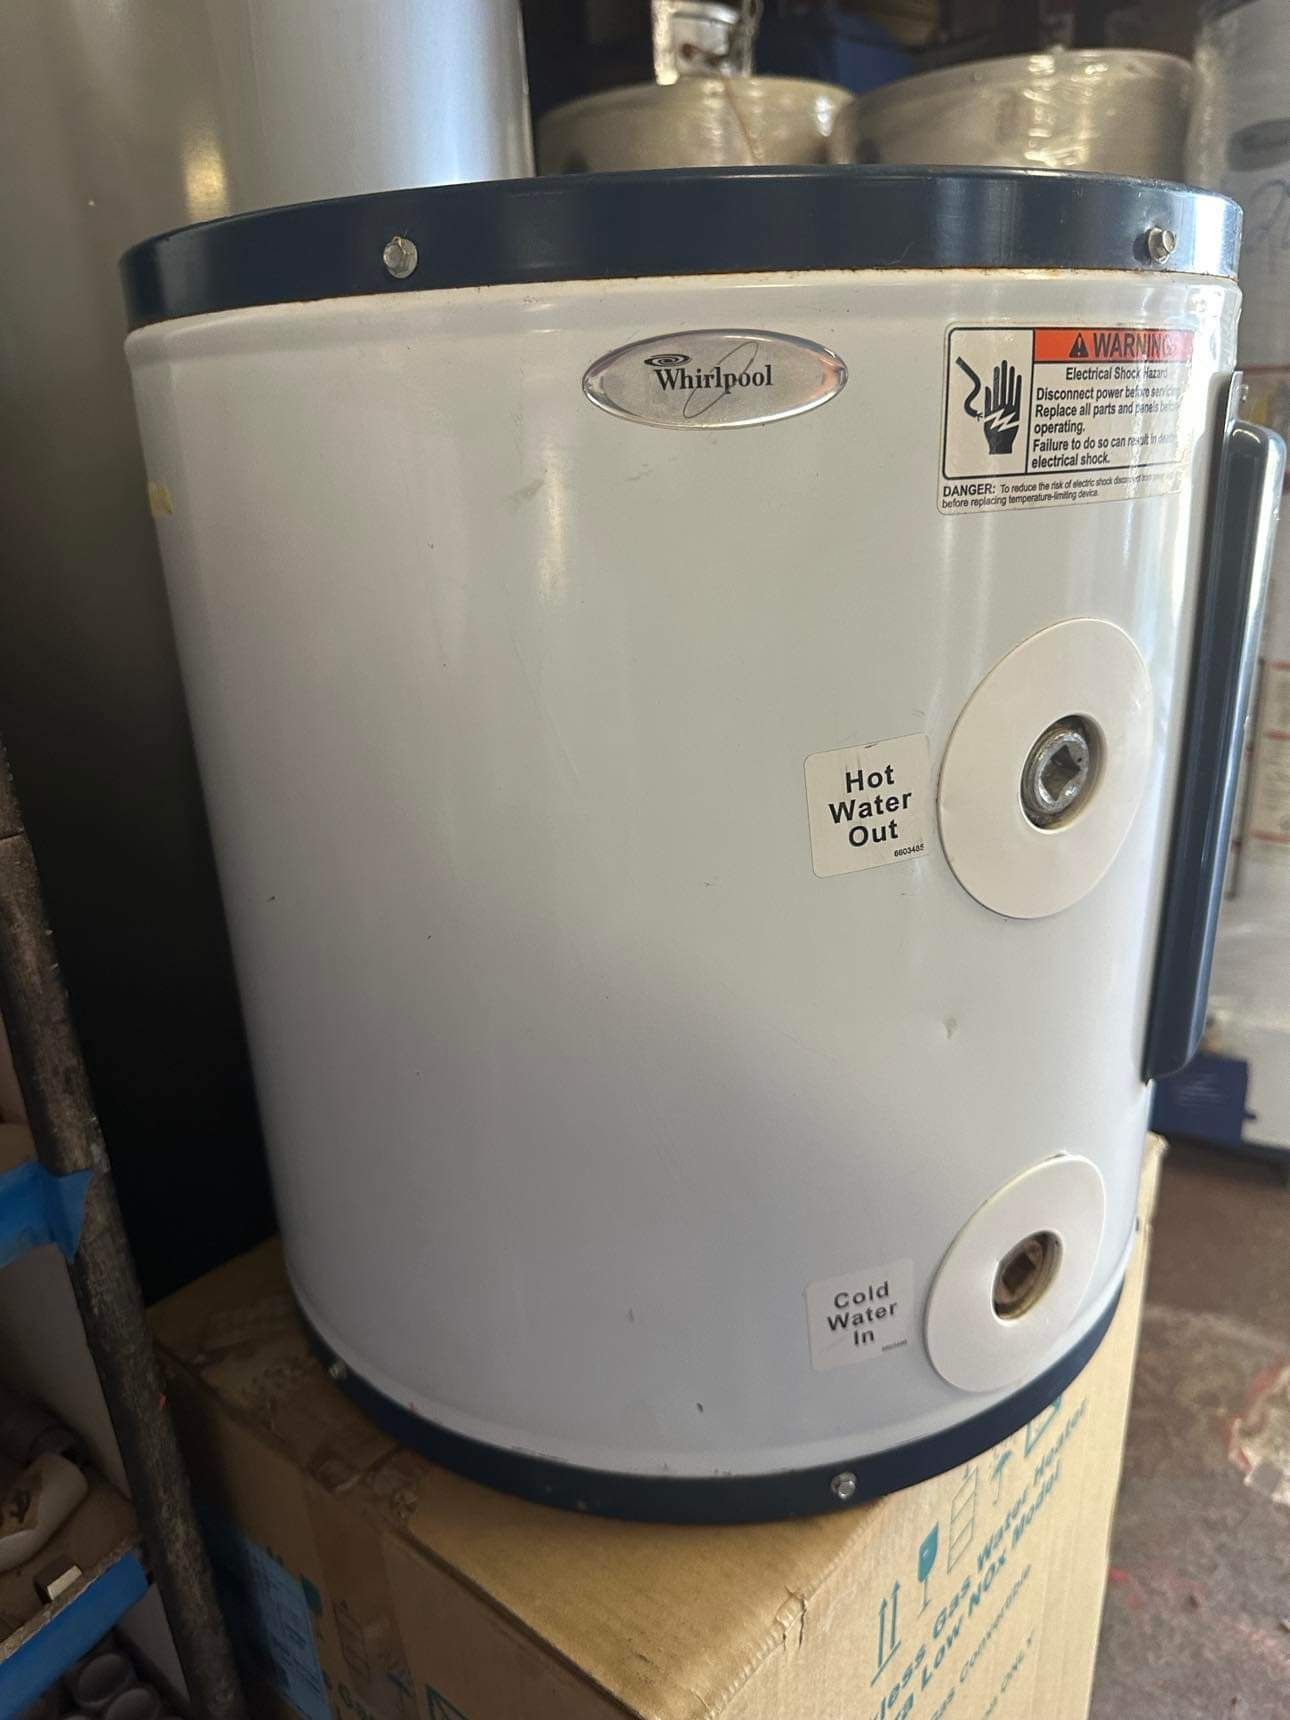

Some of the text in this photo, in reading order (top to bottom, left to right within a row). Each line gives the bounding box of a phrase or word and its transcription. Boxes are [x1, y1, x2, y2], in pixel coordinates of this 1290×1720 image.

[654, 364, 772, 394] Whirlpool
[1066, 366, 1111, 380] Electrical
[1114, 365, 1140, 380] Shock
[1036, 388, 1094, 401] Disconnect
[1096, 388, 1124, 400] power
[1035, 404, 1077, 418] Replace
[1079, 403, 1091, 416] all
[1093, 403, 1116, 418] parts
[1118, 402, 1133, 415] and
[1034, 420, 1086, 435] operating.
[1033, 438, 1068, 452] Failure
[1071, 438, 1081, 450] to
[1083, 437, 1096, 450] do
[1098, 438, 1109, 448] so
[1111, 437, 1126, 448] can
[1031, 452, 1110, 468] electrical shock.
[943, 484, 996, 498] DANGER:
[1000, 484, 1010, 494] To
[1011, 481, 1037, 492] reduce
[1038, 480, 1050, 491] the
[1051, 480, 1063, 490] risk
[1065, 479, 1072, 490] of
[1072, 477, 1094, 488] electric
[1096, 476, 1112, 486] shock
[942, 498, 968, 509] before
[970, 496, 1006, 508] replacing
[1008, 491, 1076, 506] temperature-limiting
[845, 764, 894, 793] Hot
[828, 792, 912, 824] Water
[848, 819, 898, 847] Out
[833, 1280, 889, 1309] Cold
[826, 1301, 897, 1331] Water
[853, 1330, 874, 1345] In
[932, 1575, 971, 1640] Gas
[920, 1614, 963, 1692] Low
